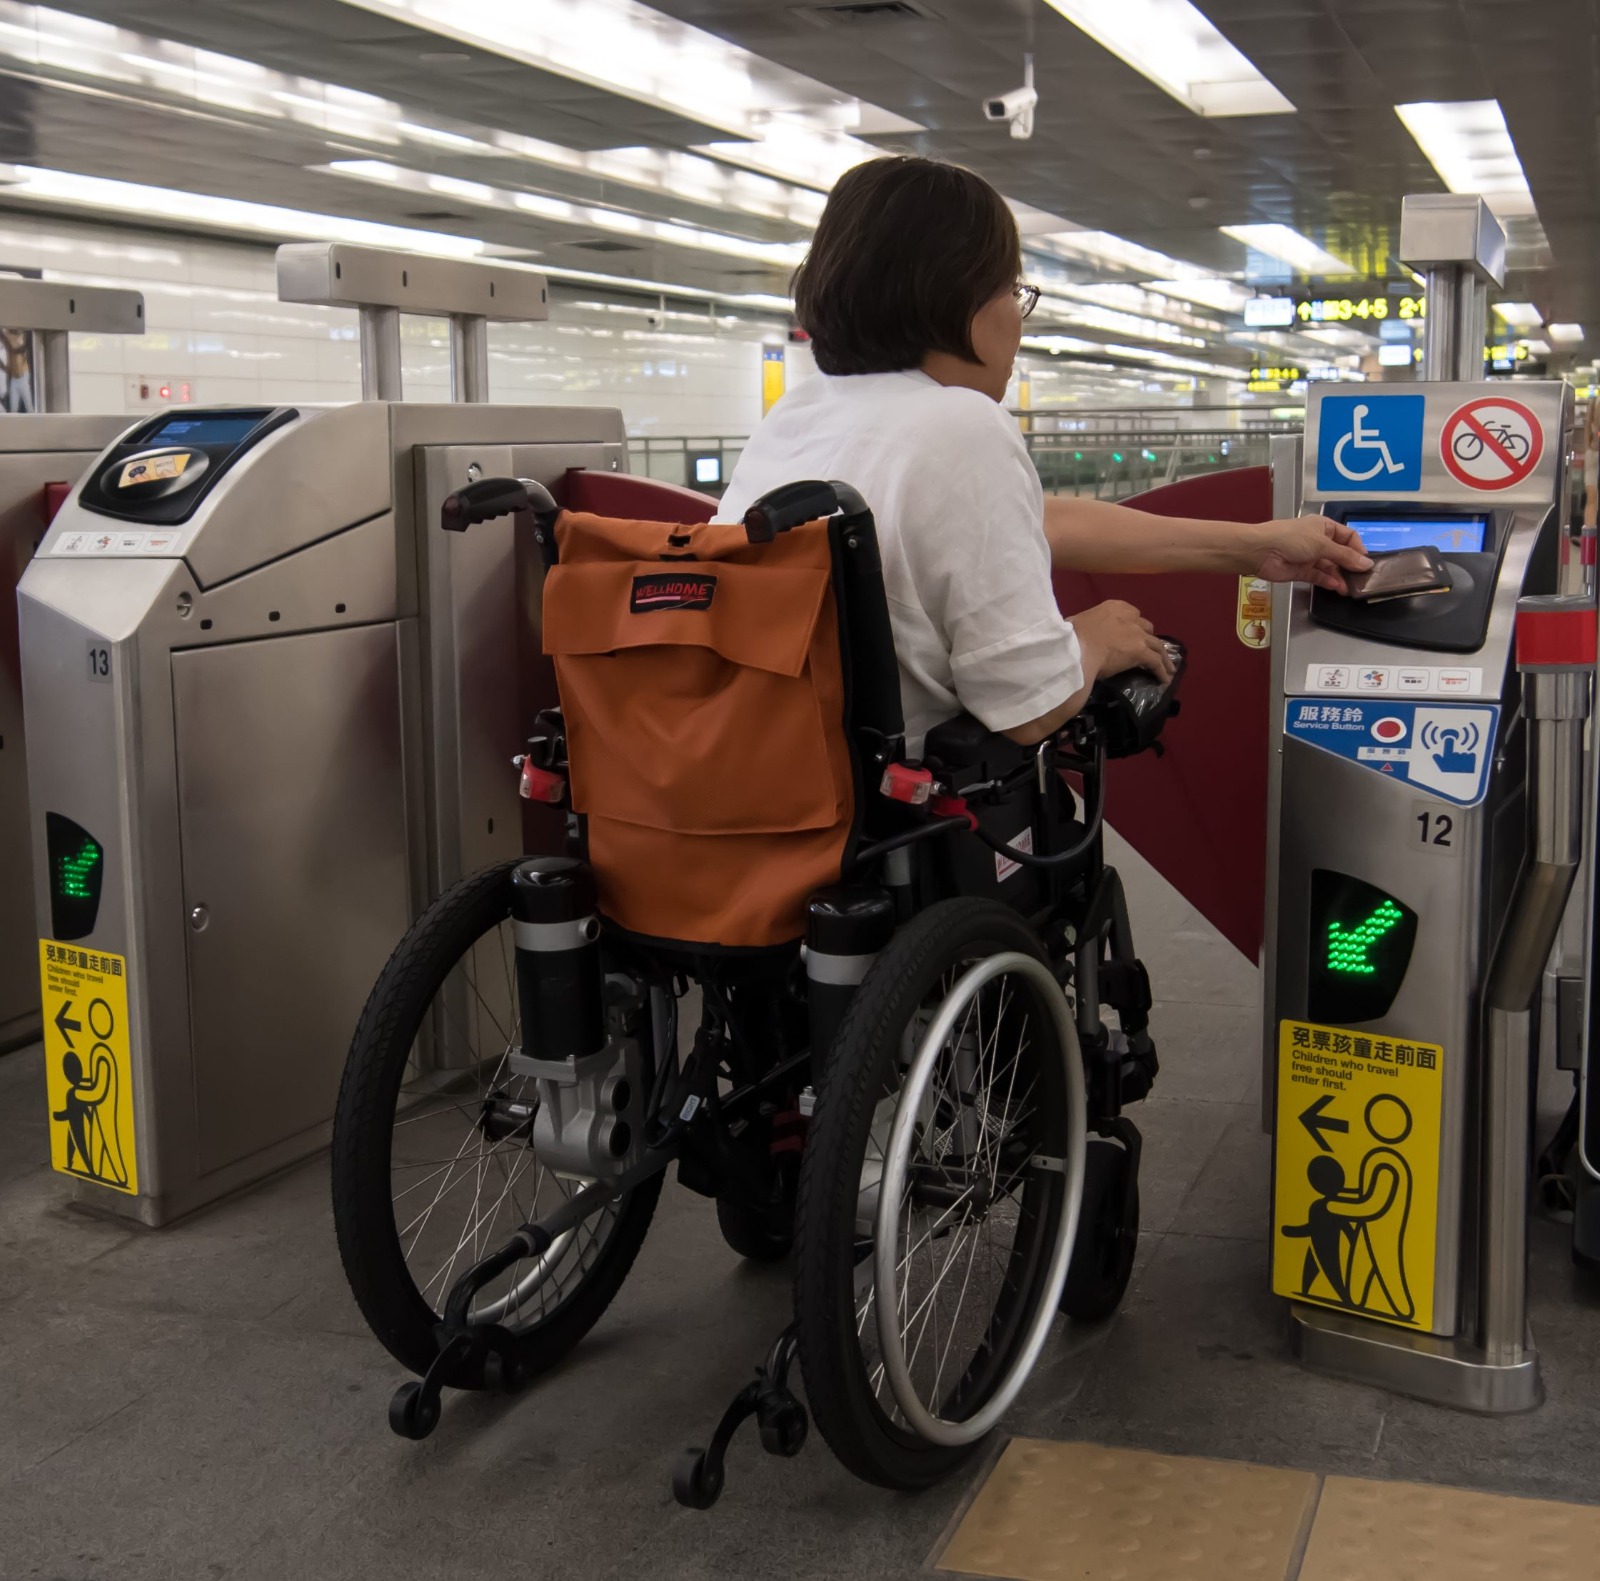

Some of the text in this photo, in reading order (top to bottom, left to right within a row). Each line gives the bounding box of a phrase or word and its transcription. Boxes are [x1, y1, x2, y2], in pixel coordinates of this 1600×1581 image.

[636, 583, 708, 598] WELLHOME
[90, 648, 109, 676] 13
[1299, 706, 1363, 722] 服務鈴
[1293, 721, 1365, 731] Service Button
[1417, 811, 1453, 847] 12
[1291, 1026, 1436, 1071] 免票孩童走前面
[1291, 1050, 1399, 1078] Children who travel
[1291, 1061, 1353, 1081] free should
[1291, 1074, 1347, 1091] enter first.
